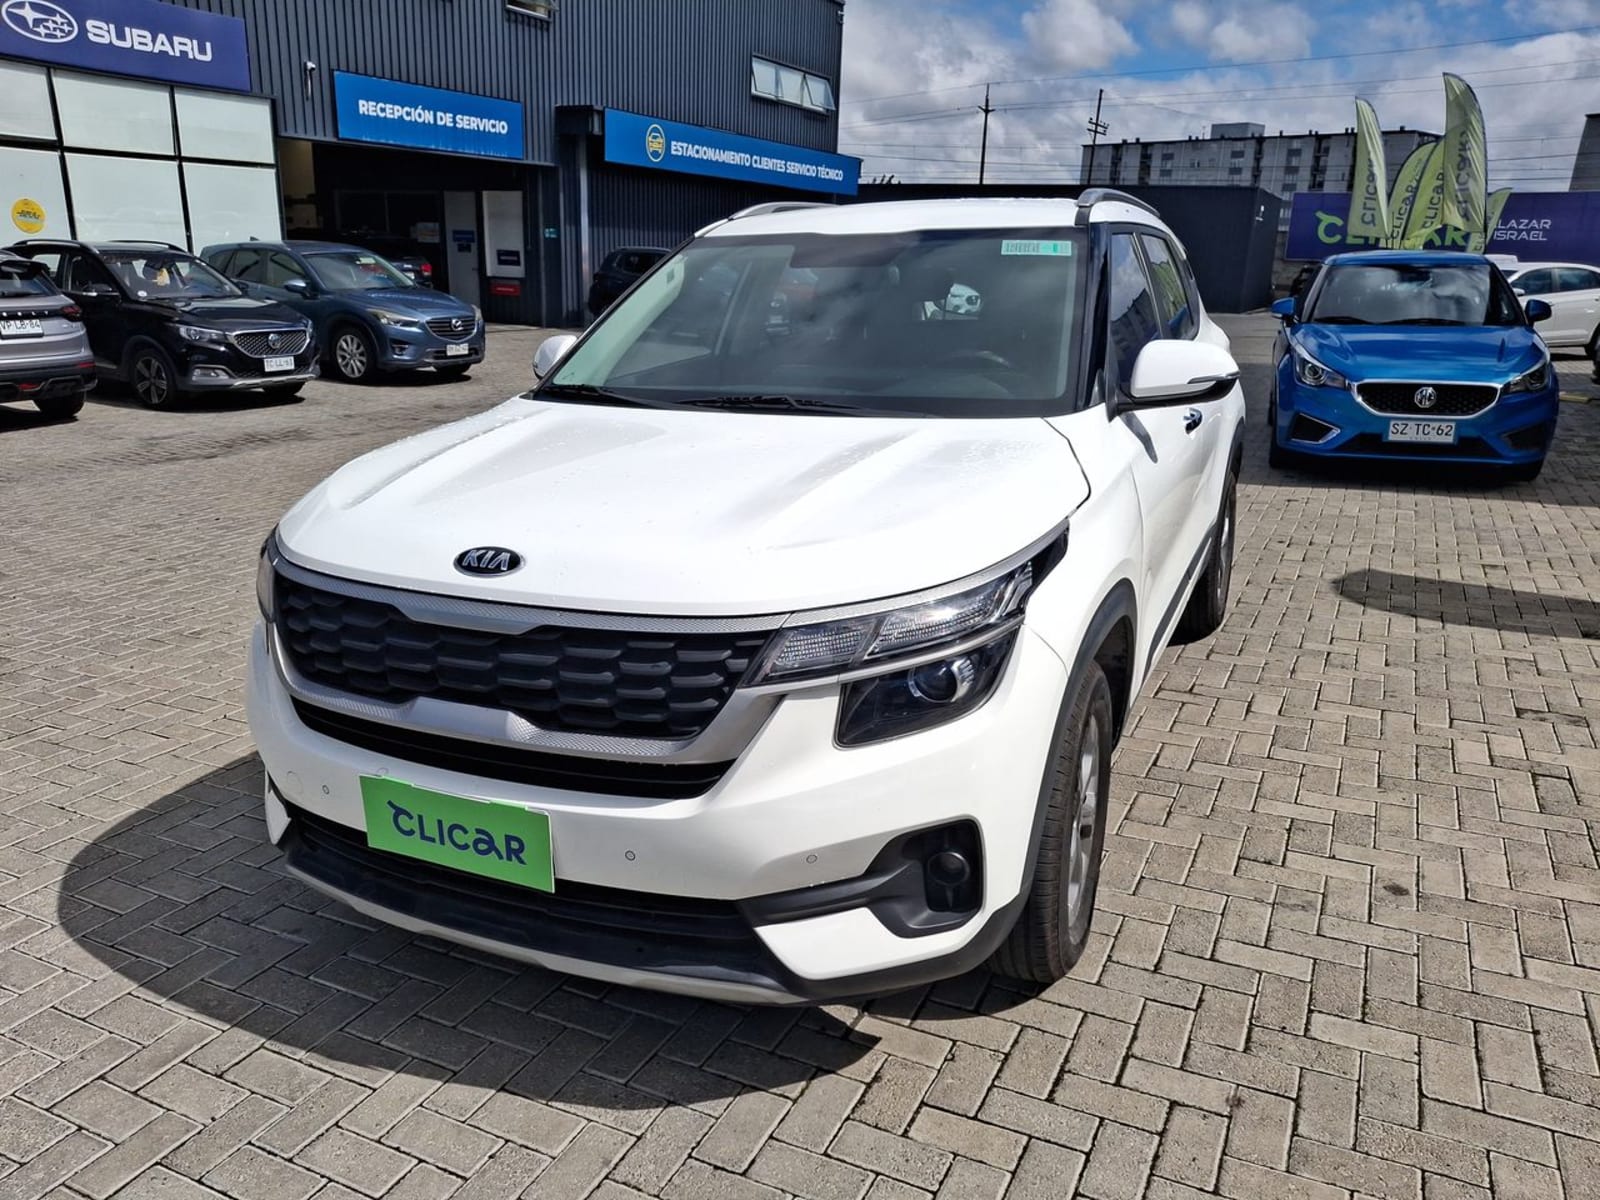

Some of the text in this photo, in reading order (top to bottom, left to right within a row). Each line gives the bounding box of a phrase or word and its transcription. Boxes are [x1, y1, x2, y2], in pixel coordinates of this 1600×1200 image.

[86, 19, 212, 62] SUBARU
[358, 99, 509, 134] RECEPCIÓN DE SERVICIO
[670, 141, 844, 181] ESTACIONAMIENTO CLIENTES SERVICIO TÉCNICO
[1493, 230, 1548, 241] ISRAEL
[1495, 219, 1552, 229] LAZAR
[461, 549, 511, 571] KIA
